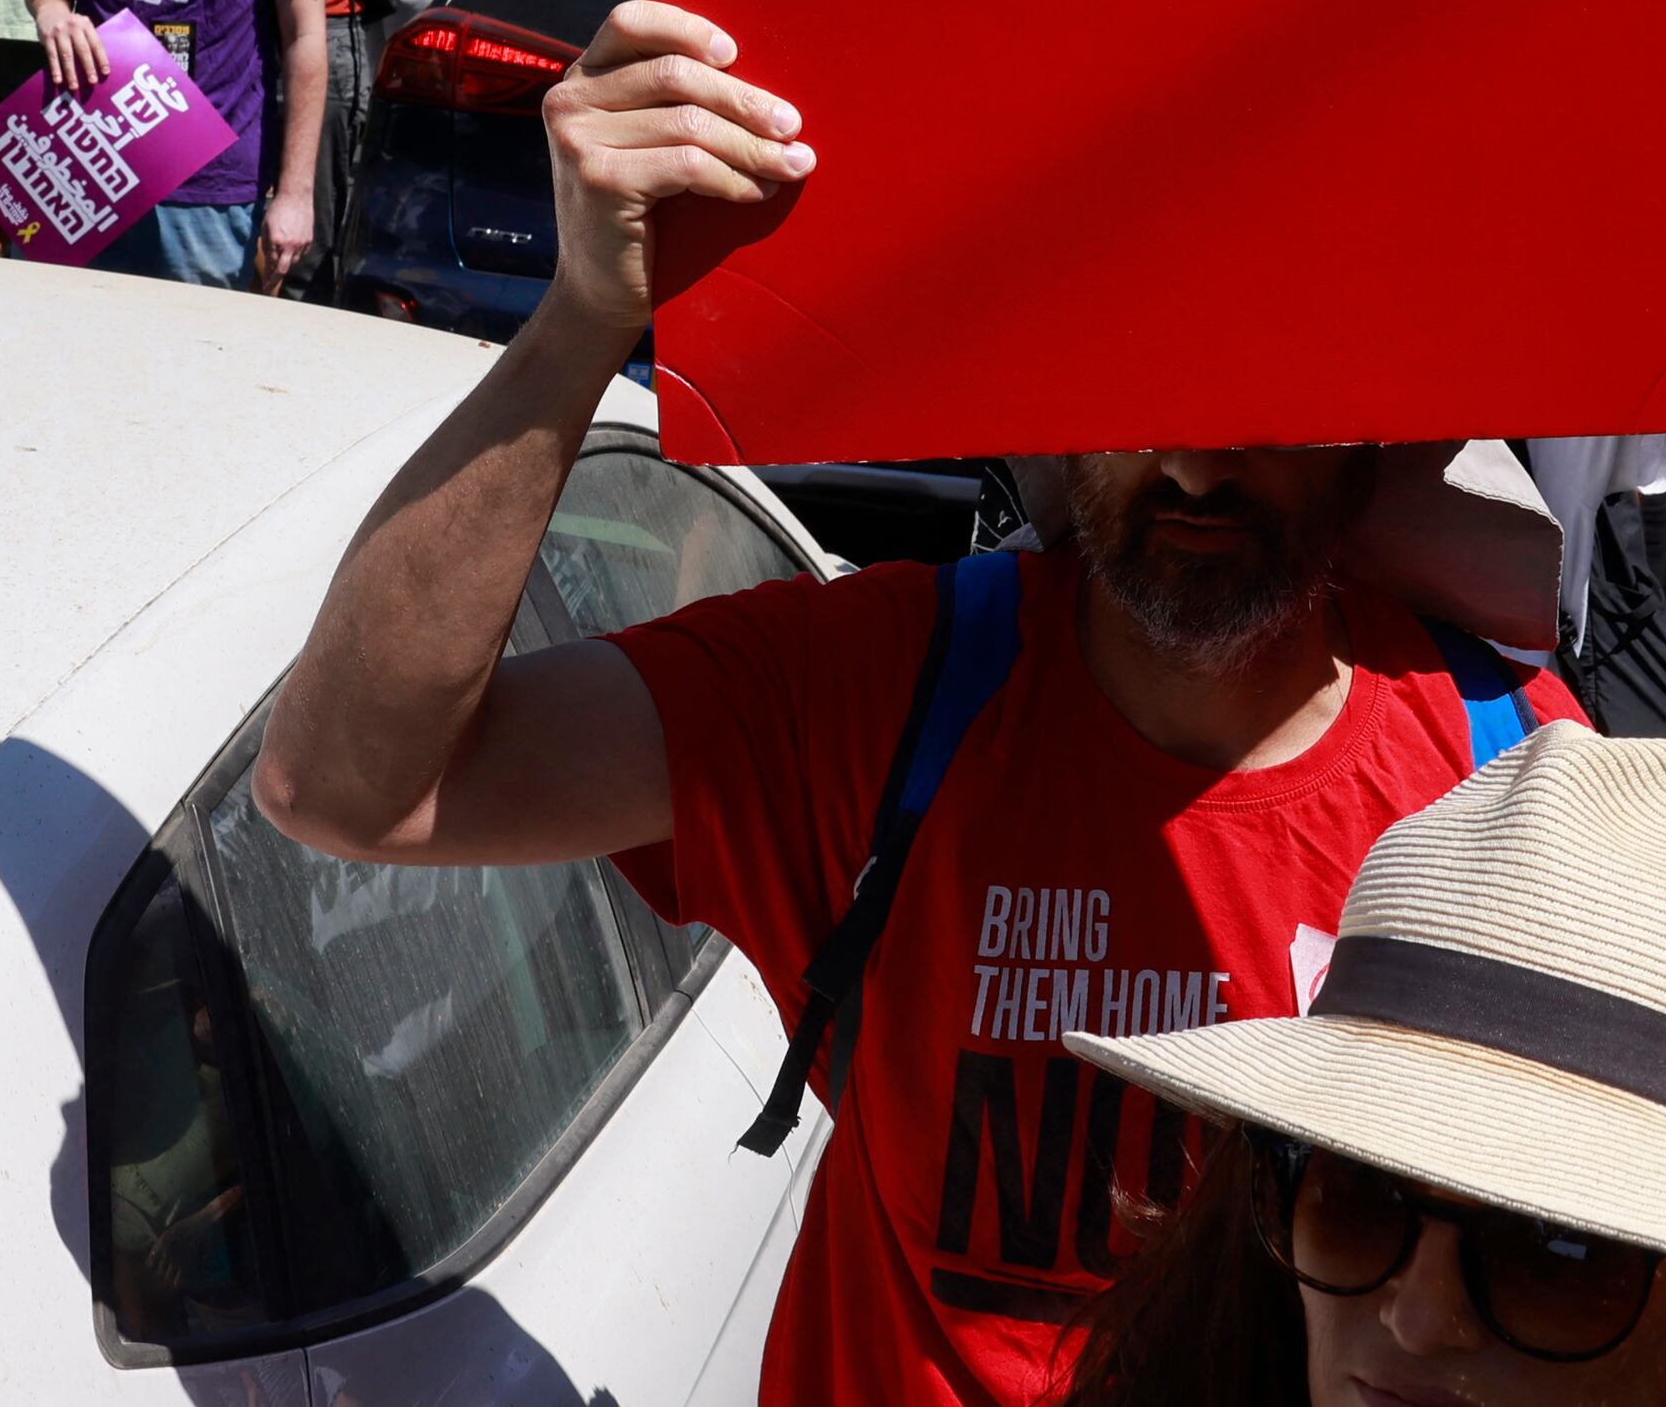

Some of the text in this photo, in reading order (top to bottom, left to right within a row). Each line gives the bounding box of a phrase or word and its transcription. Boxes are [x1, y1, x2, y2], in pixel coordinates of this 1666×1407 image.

[123, 90, 162, 126] עד
[133, 62, 190, 113] حتى
[0, 134, 85, 239] האחרון
[54, 102, 130, 198] החטוף
[977, 885, 1111, 962] BRING
[971, 965, 1230, 1042] THEM HOME
[936, 1049, 1198, 1280] NO
